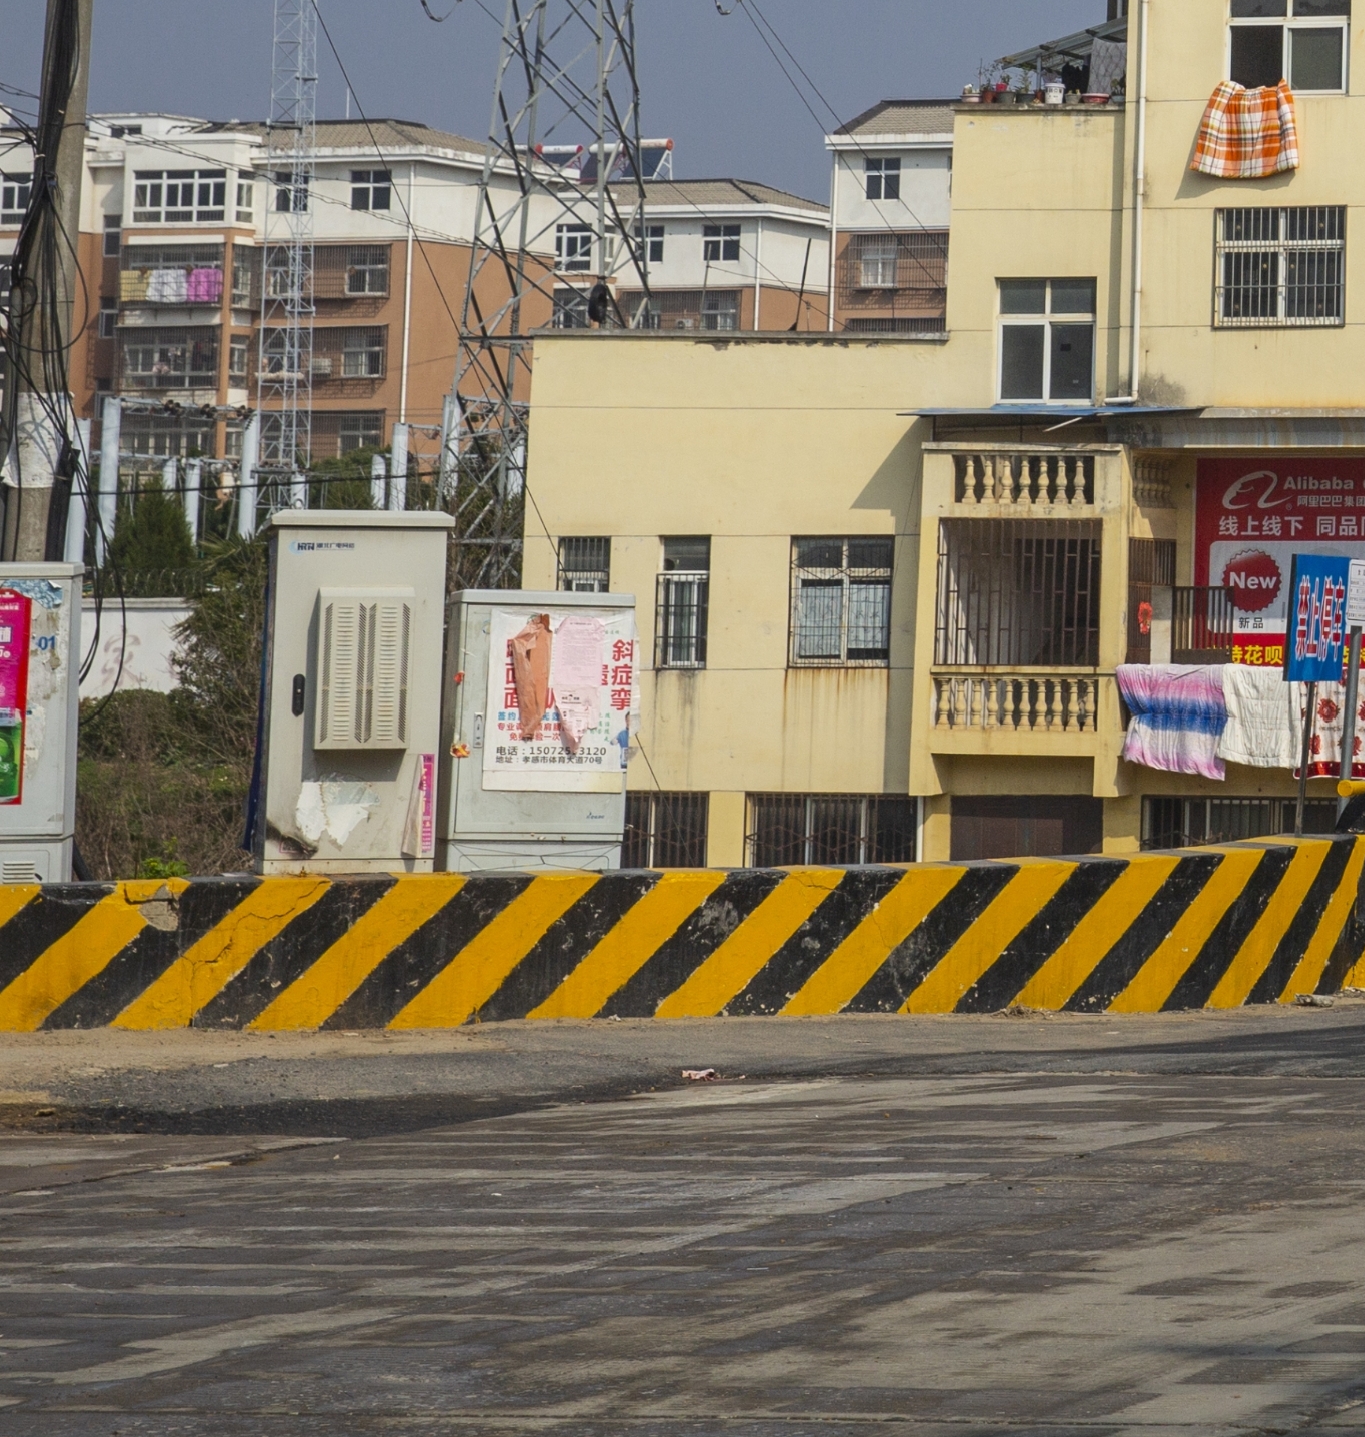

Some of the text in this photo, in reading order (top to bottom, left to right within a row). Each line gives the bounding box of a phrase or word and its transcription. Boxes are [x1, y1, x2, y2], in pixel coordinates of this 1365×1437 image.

[1283, 476, 1354, 490] Alibaba
[1297, 495, 1365, 507] 阿里巴巴集团
[1218, 515, 1304, 536] 线上线下
[1229, 571, 1277, 590] New
[1239, 617, 1264, 629] 新品
[1295, 575, 1345, 662] 禁止停车
[1225, 645, 1283, 665] 持花呗
